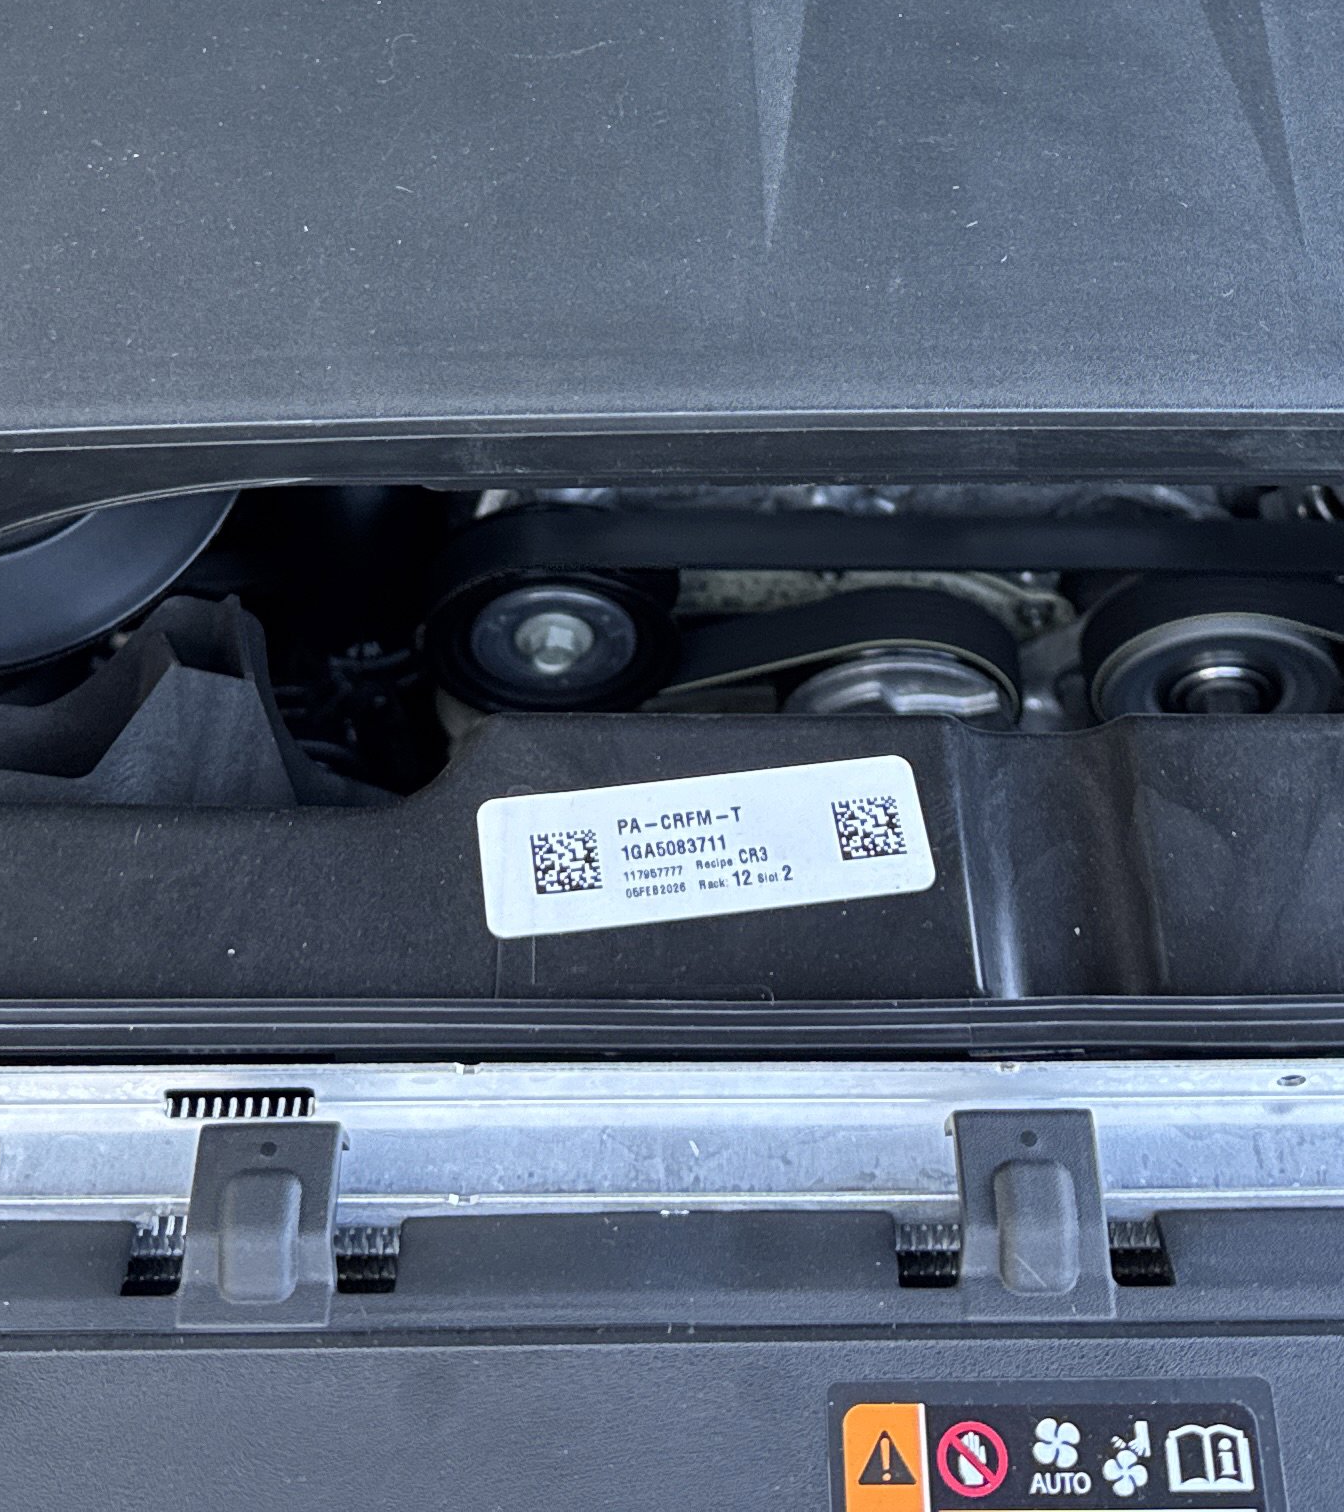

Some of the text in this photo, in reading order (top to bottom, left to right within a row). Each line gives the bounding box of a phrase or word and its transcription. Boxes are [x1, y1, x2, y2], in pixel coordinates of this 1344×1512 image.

[620, 833, 727, 862] 1GA5083711
[737, 845, 769, 865] CR3
[731, 868, 754, 888] 12
[781, 863, 794, 883] 2
[1029, 1471, 1092, 1496] AUTO
